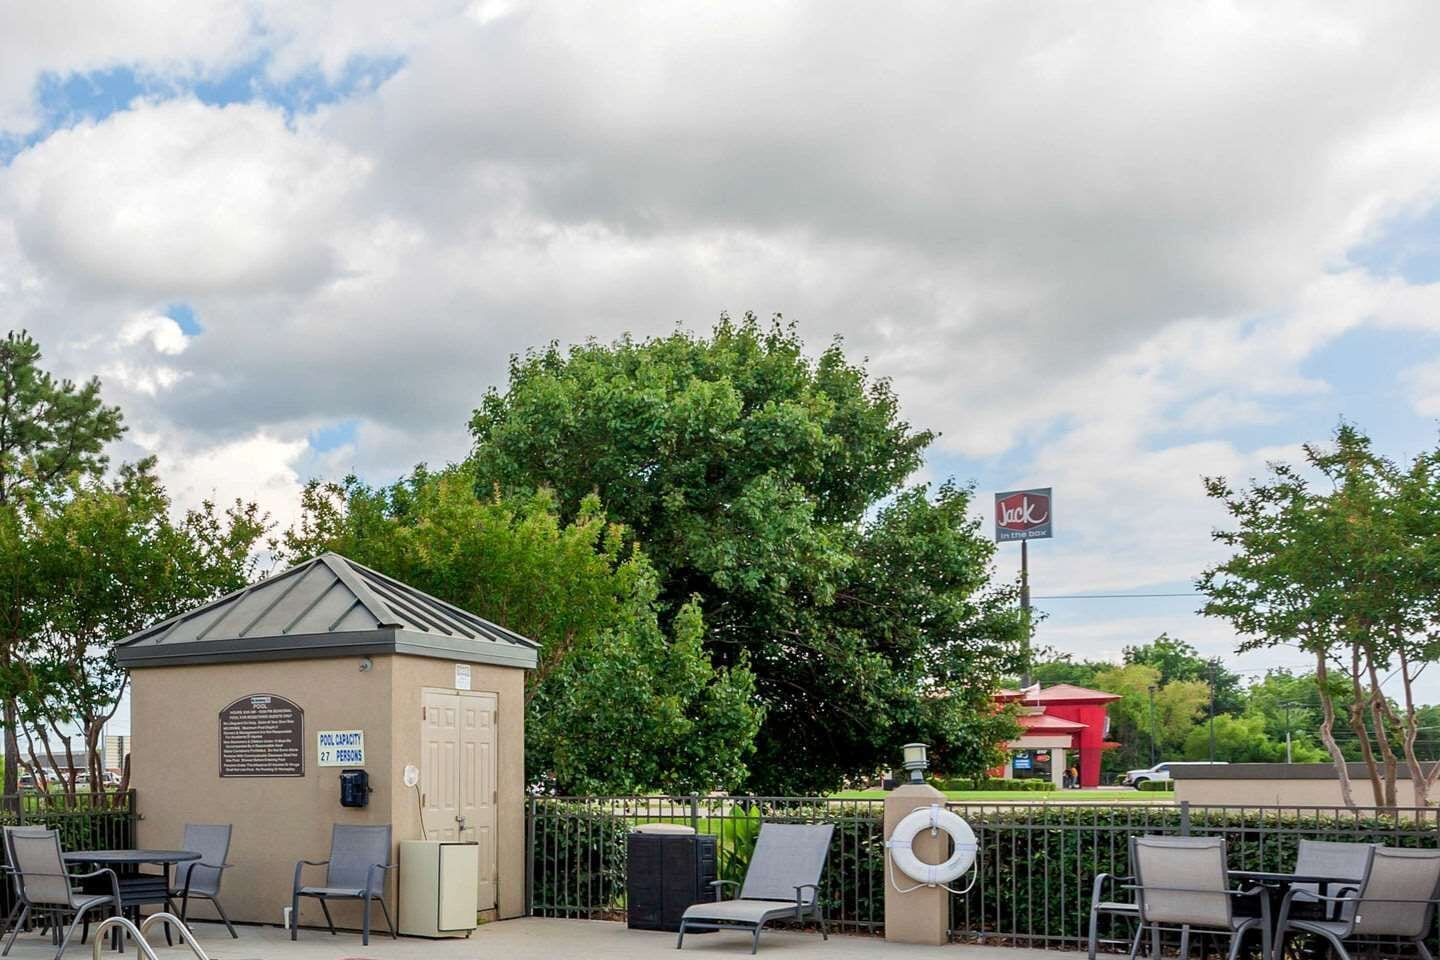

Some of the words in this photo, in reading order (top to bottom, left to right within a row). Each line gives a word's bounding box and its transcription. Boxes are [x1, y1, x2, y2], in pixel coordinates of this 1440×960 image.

[999, 496, 1048, 526] Jack
[320, 734, 335, 746] POOL
[335, 733, 361, 745] CAPACITY
[336, 750, 362, 762] PERSONS
